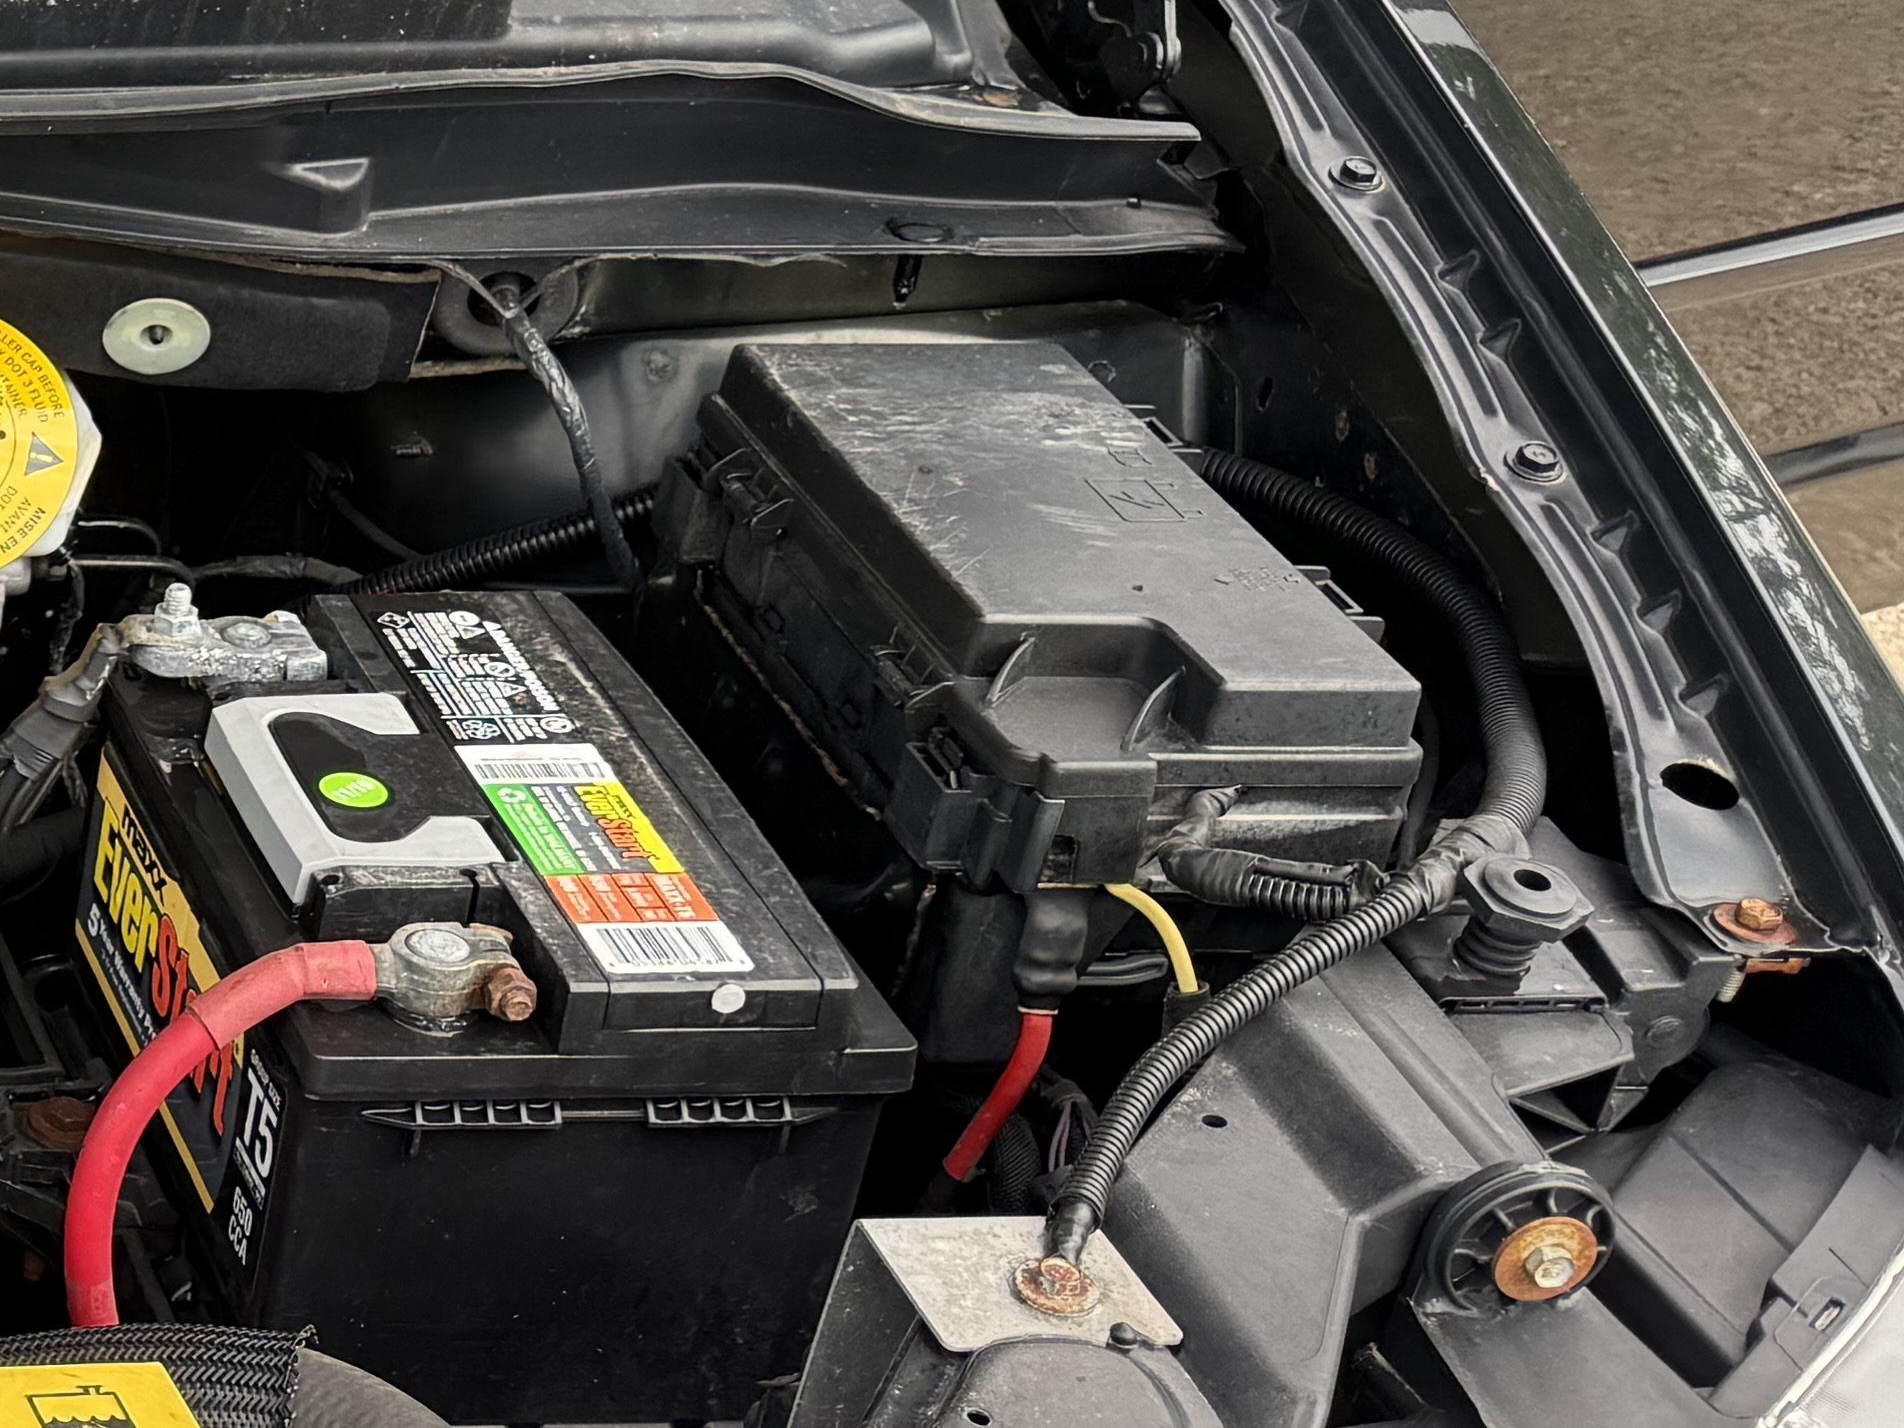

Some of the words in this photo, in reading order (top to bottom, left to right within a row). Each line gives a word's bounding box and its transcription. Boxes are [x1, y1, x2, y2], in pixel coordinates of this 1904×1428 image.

[5, 355, 28, 379] DOT
[22, 377, 33, 388] 3
[28, 387, 50, 424] FLUID
[21, 346, 43, 374] CAP
[41, 372, 64, 418] BEFORE
[2, 497, 32, 530] AVANT
[20, 507, 46, 538] MISE
[0, 536, 19, 554] EN
[87, 903, 101, 938] 5
[94, 798, 234, 1138] EverStt
[243, 1068, 278, 1179] T5
[232, 1185, 253, 1237] 650
[228, 1214, 248, 1266] CCA
